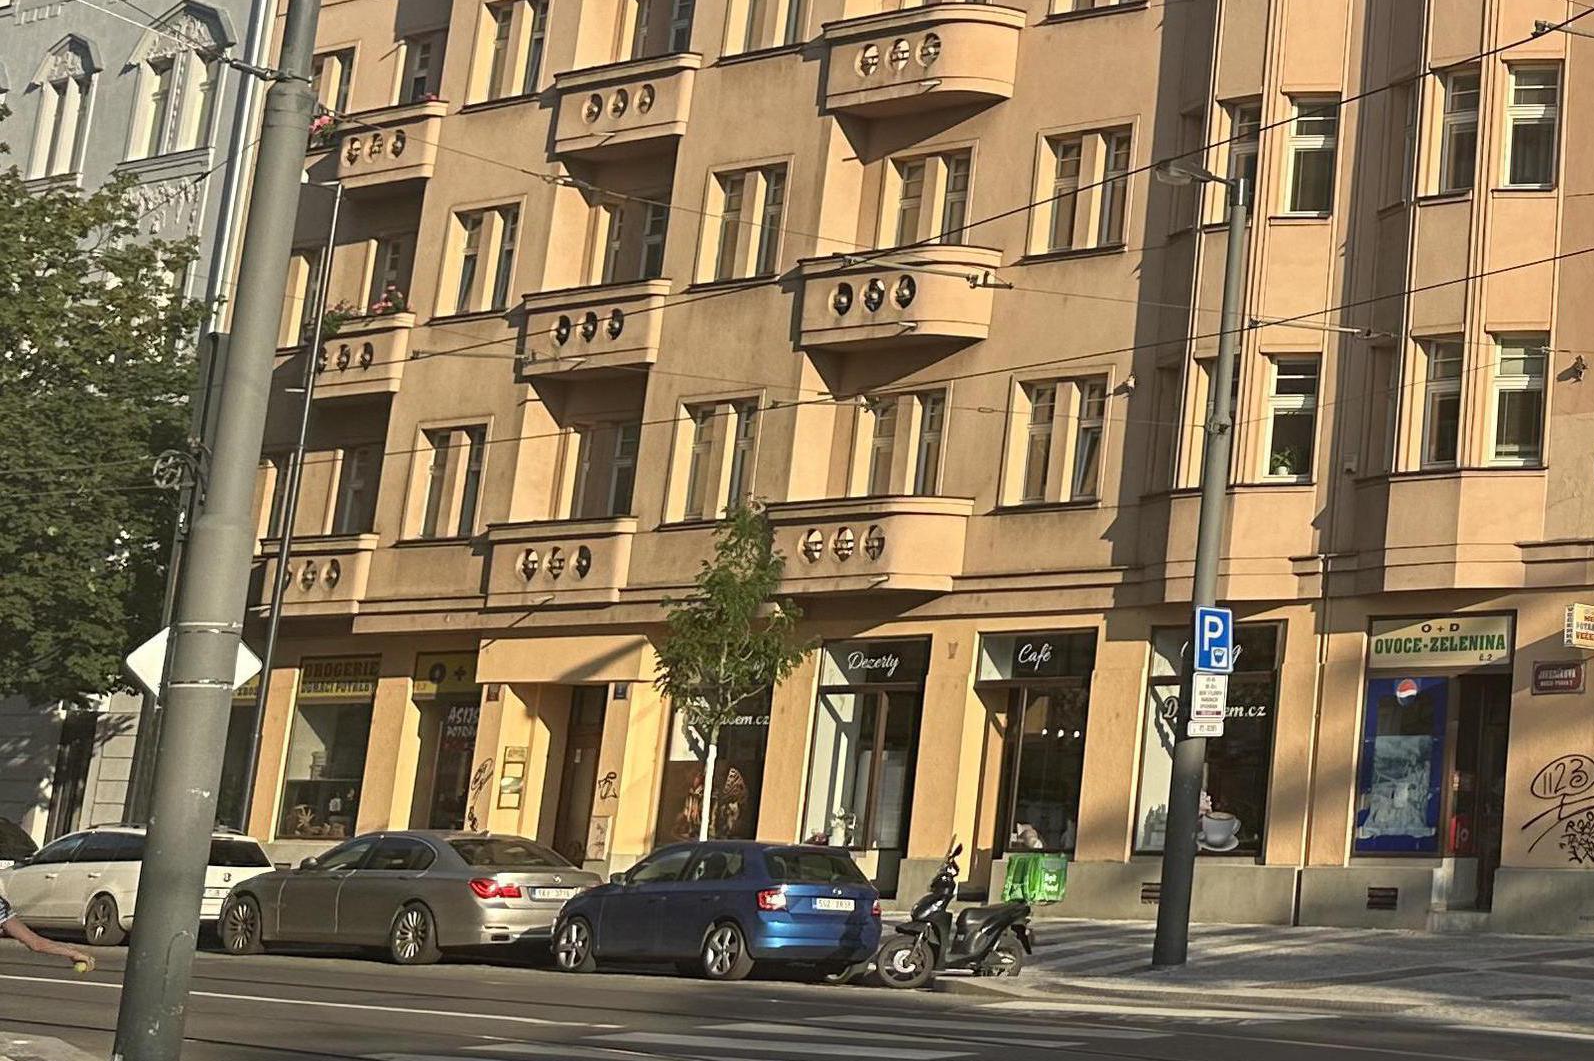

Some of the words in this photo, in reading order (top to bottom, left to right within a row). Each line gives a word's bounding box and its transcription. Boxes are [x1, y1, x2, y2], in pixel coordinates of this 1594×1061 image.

[1204, 615, 1224, 651] P
[1421, 624, 1432, 633] O
[1449, 623, 1460, 632] D
[1374, 634, 1506, 655] OVOCE-ZELENINA
[847, 651, 901, 677] Dezerty
[1018, 643, 1053, 671] Café
[304, 661, 380, 678] DROGERIE
[428, 663, 446, 684] O
